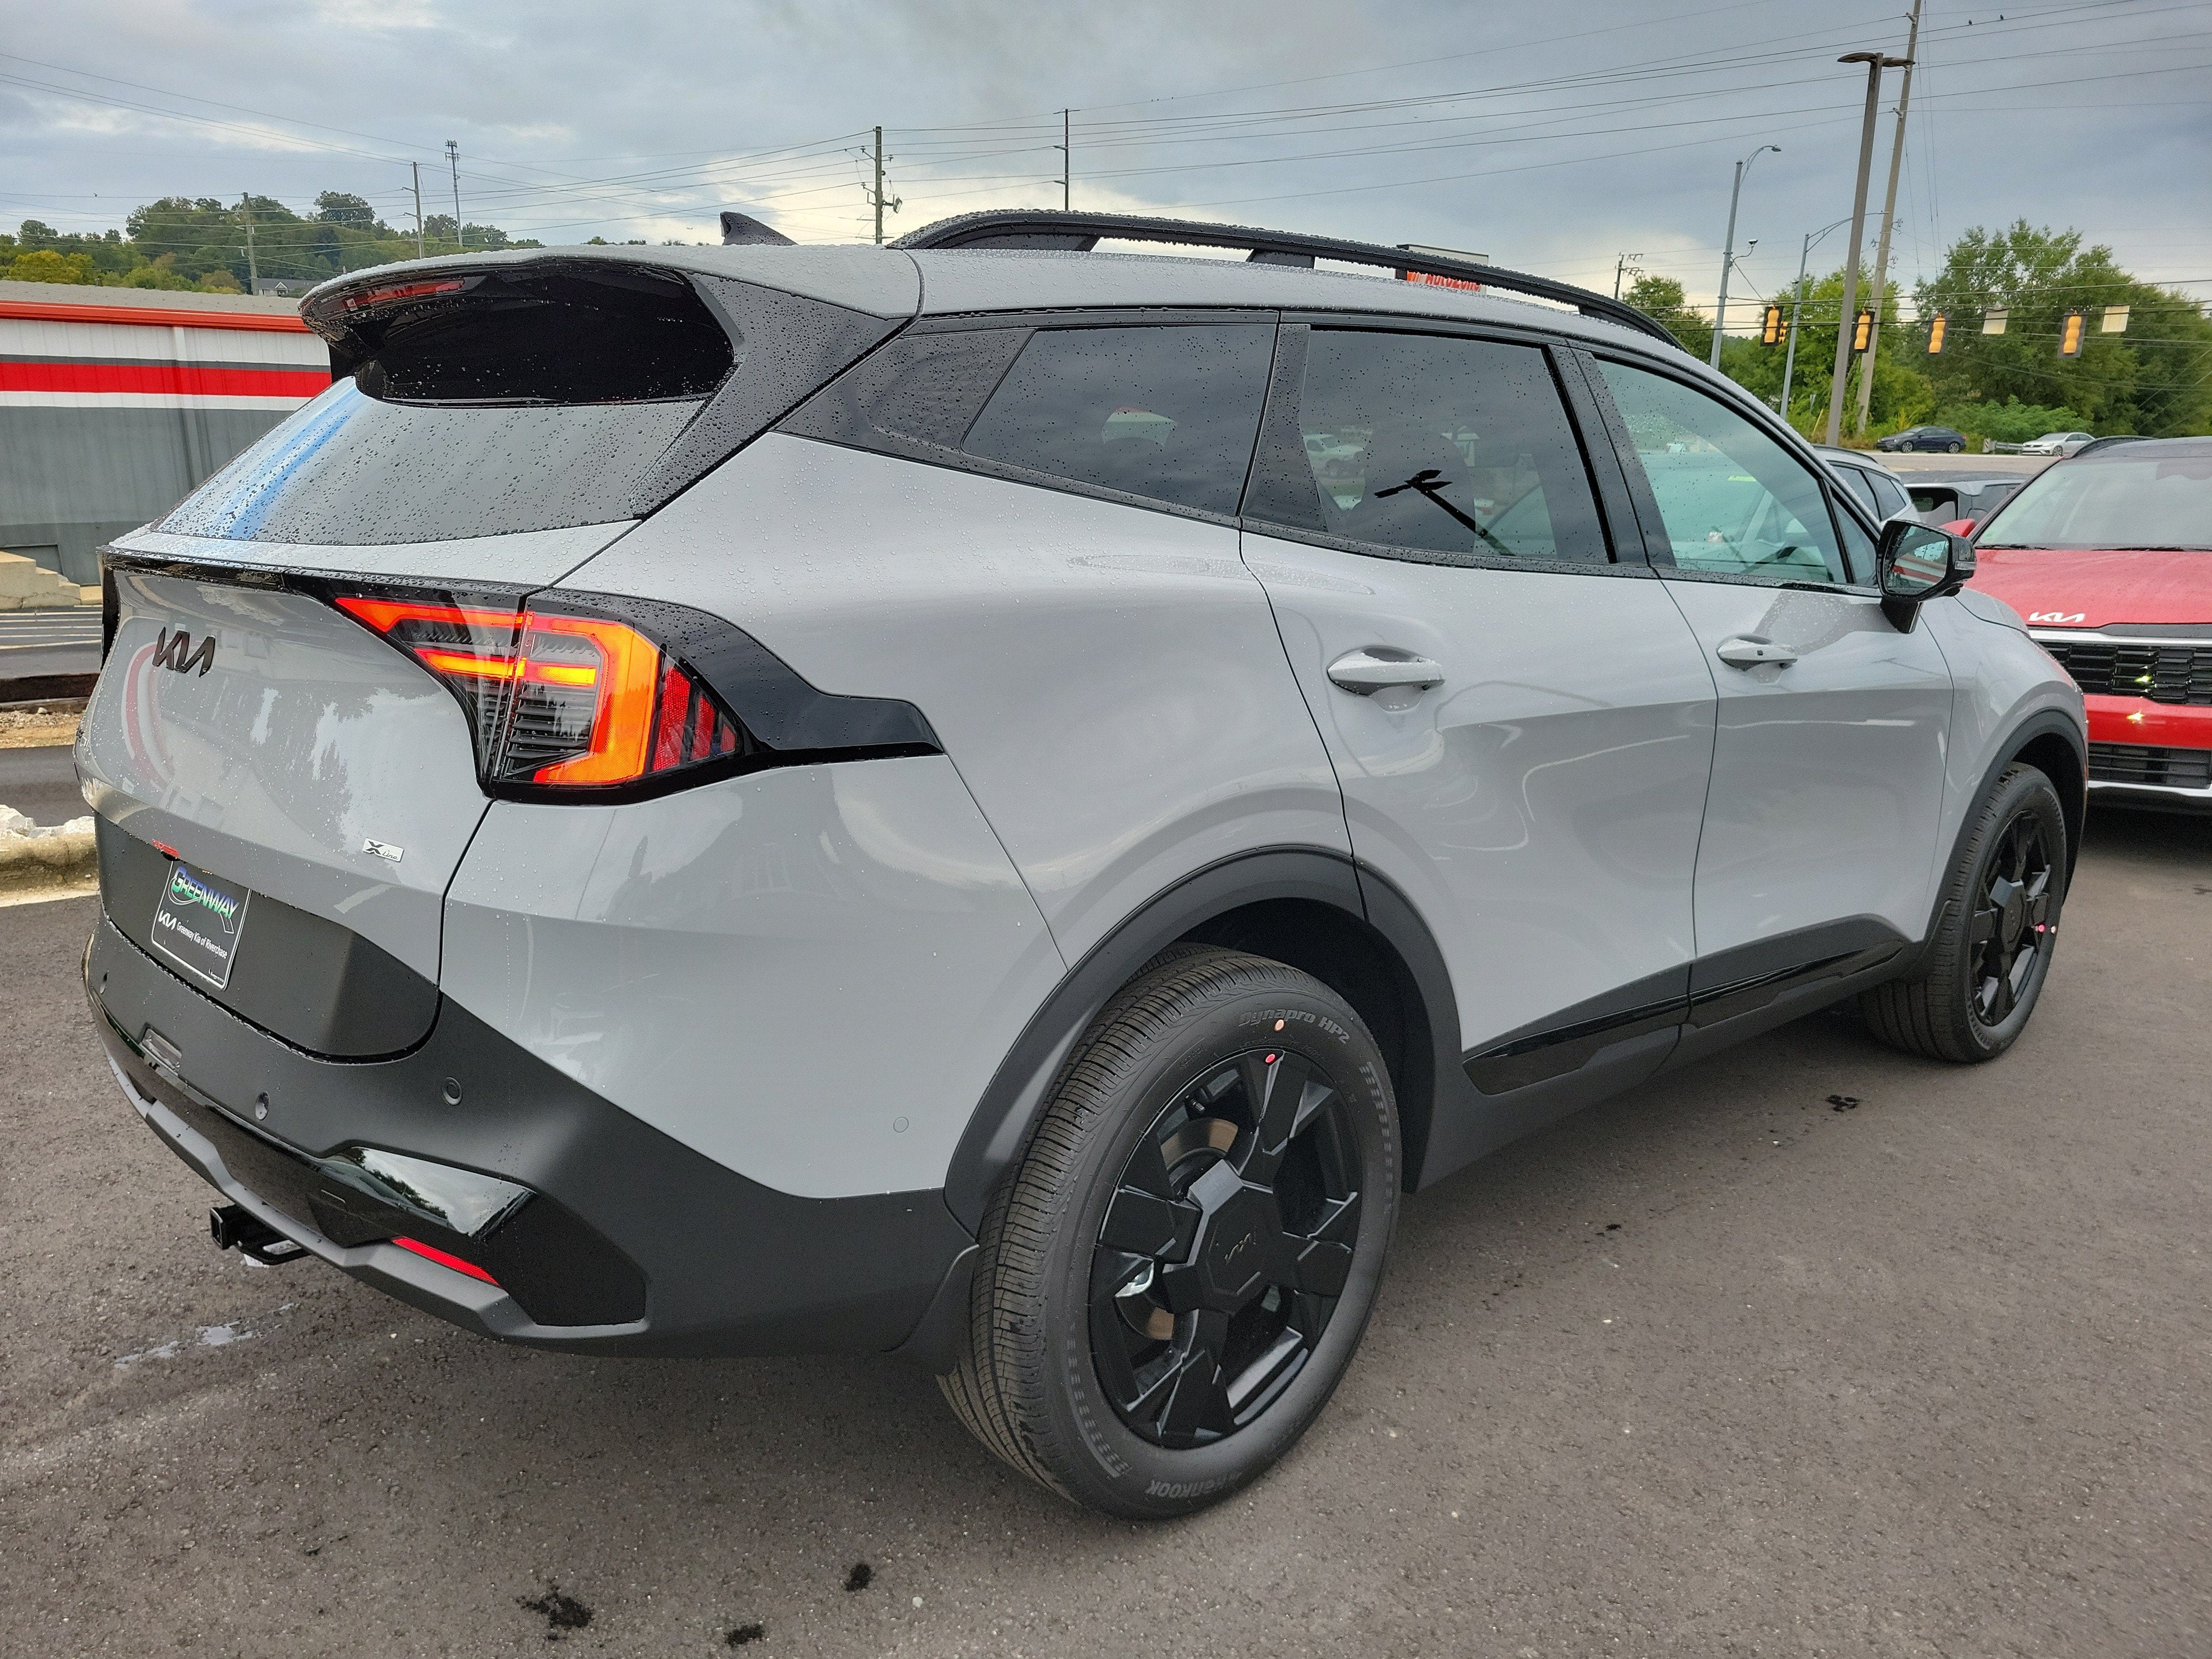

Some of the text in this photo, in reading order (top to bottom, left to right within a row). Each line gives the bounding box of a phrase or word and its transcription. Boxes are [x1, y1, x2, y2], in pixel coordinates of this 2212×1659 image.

[2028, 611, 2085, 623] KIA
[152, 626, 216, 678] KIA
[172, 866, 240, 919] GREENWAY
[177, 921, 195, 941] Greenway
[200, 936, 207, 946] of
[205, 939, 228, 960] Riverchase
[1318, 1016, 1351, 1045] HP2
